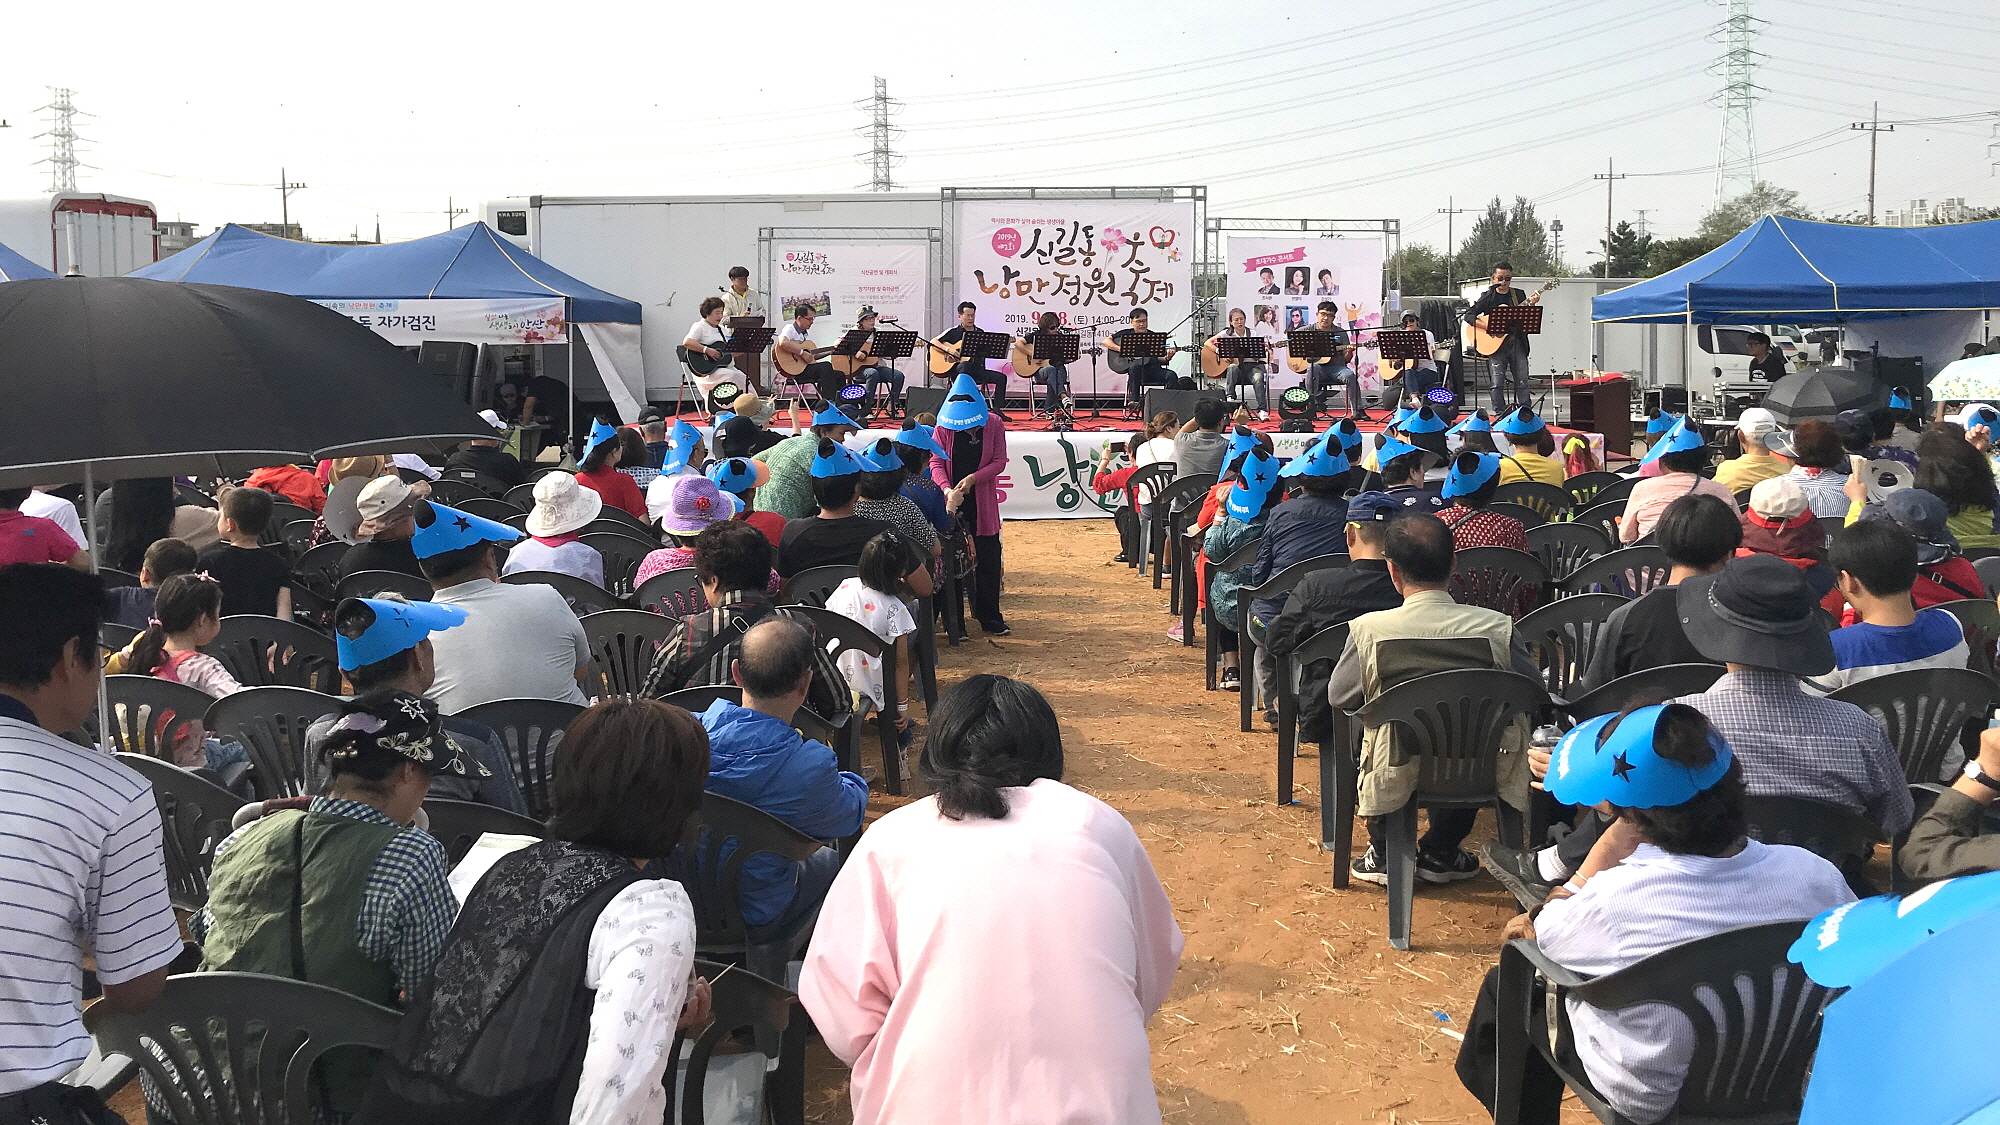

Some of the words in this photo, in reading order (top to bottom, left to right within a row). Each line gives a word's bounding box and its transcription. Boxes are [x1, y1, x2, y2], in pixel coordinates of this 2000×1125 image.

[997, 233, 1017, 241] 2019년
[997, 241, 1015, 251] 제2회
[1021, 220, 1097, 267] 신길동
[794, 251, 815, 264] 신길동
[1256, 256, 1276, 265] 초대가수
[1278, 253, 1295, 263] 콘서트
[781, 263, 821, 275] 낭만정원
[974, 265, 1120, 306] 낭만정원
[348, 302, 376, 310] 낭만정원
[377, 315, 436, 331] 자가검진
[519, 318, 545, 330] 안산
[1005, 314, 1028, 323] 2019.
[1073, 315, 1088, 325] (토)
